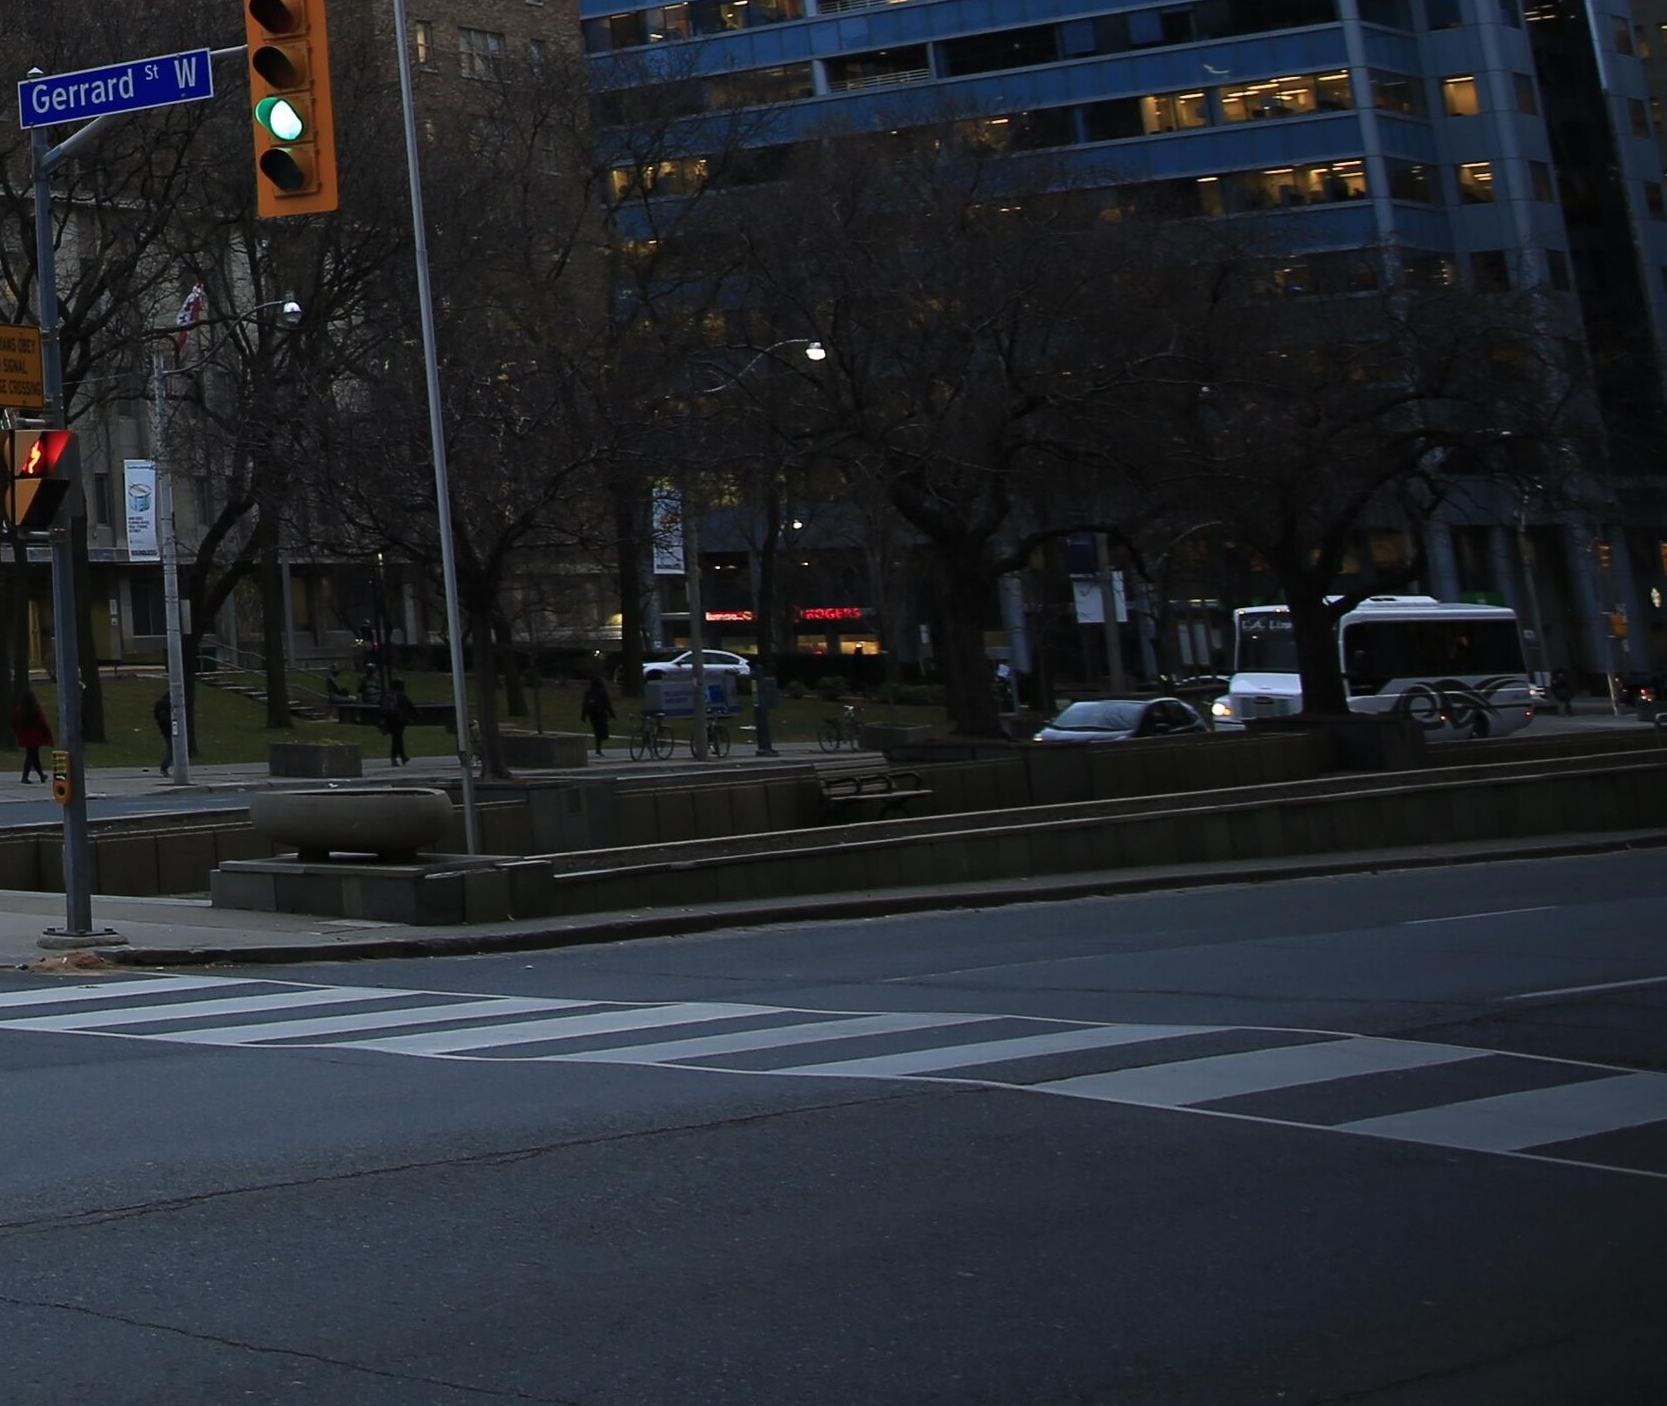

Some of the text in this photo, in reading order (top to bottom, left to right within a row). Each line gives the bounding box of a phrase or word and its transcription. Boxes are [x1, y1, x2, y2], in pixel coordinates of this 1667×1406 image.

[32, 57, 196, 114] Gerrard St W
[18, 338, 36, 354] OBEY
[3, 358, 27, 374] SIGNAL
[9, 380, 42, 396] CROSSING
[804, 607, 862, 622] ROGERS
